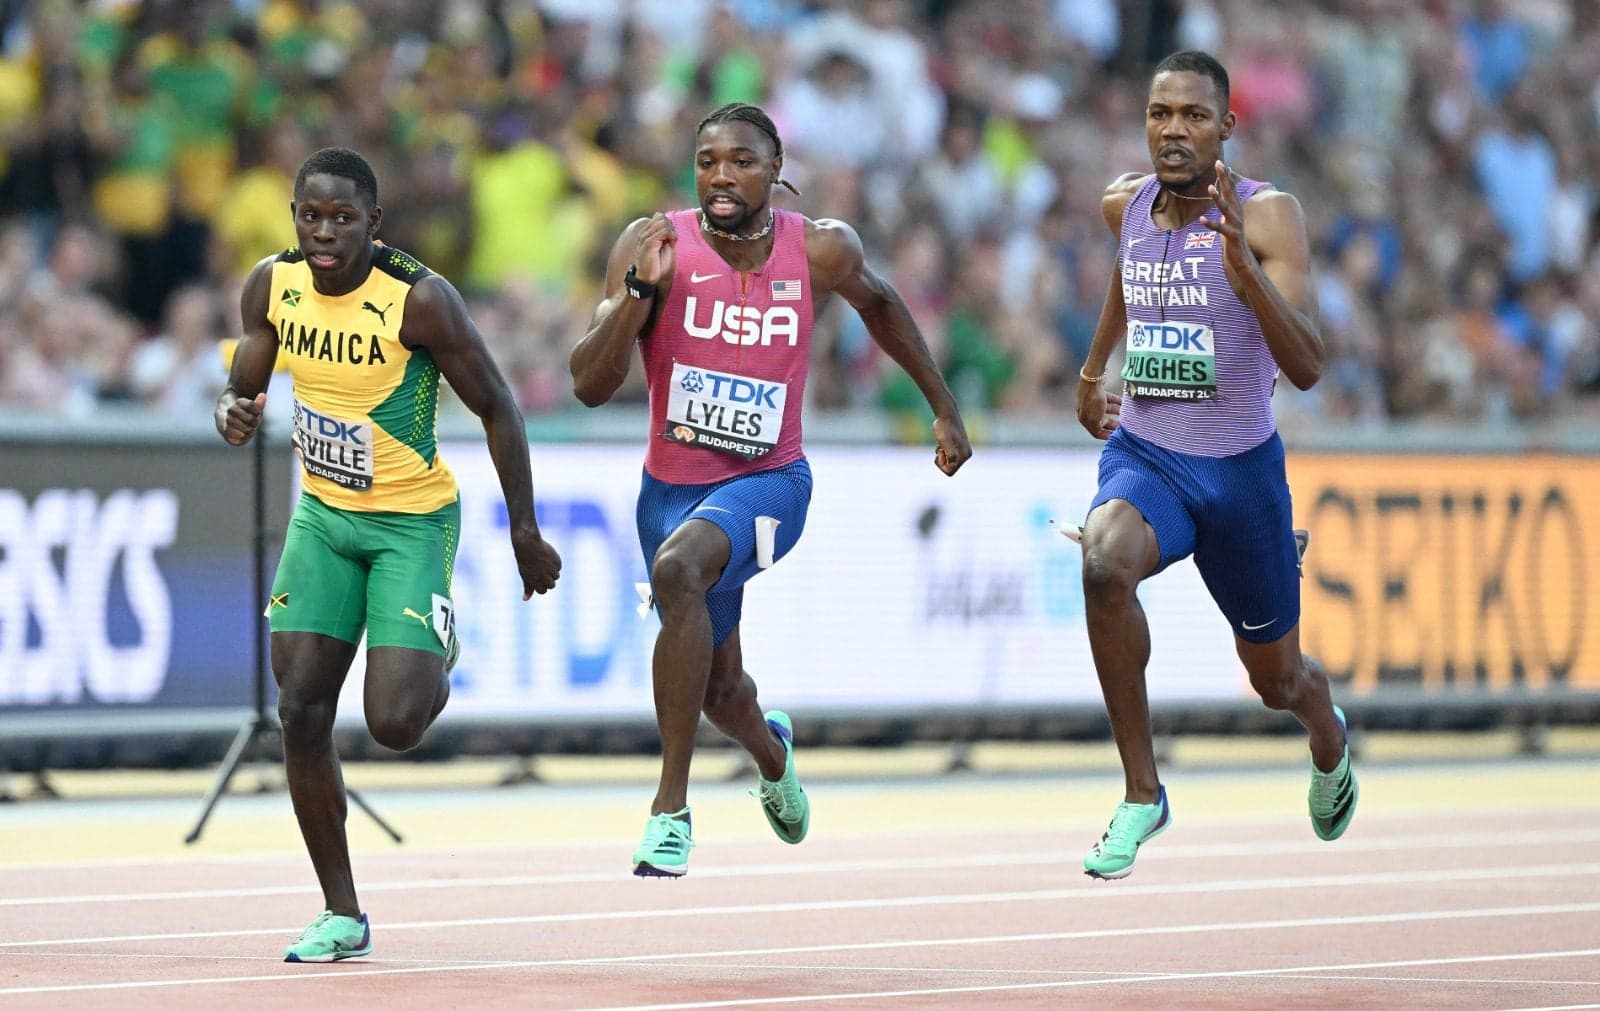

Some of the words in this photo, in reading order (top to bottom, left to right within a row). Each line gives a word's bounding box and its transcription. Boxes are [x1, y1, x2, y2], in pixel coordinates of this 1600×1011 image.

[1123, 256, 1205, 283] GREAT
[1123, 284, 1208, 307] BRITAIN
[683, 295, 799, 346] USA
[1143, 325, 1206, 351] TDK
[280, 318, 386, 365] JAMAICA
[1124, 356, 1207, 382] HUGHES
[705, 373, 780, 410] TDK
[1137, 386, 1195, 399] BUDAPEST
[301, 406, 366, 446] TDK
[686, 399, 763, 438] LYLES
[298, 428, 367, 472] EVILLE
[698, 434, 757, 456] BUDAPEST
[1306, 487, 1586, 682] SEIKO
